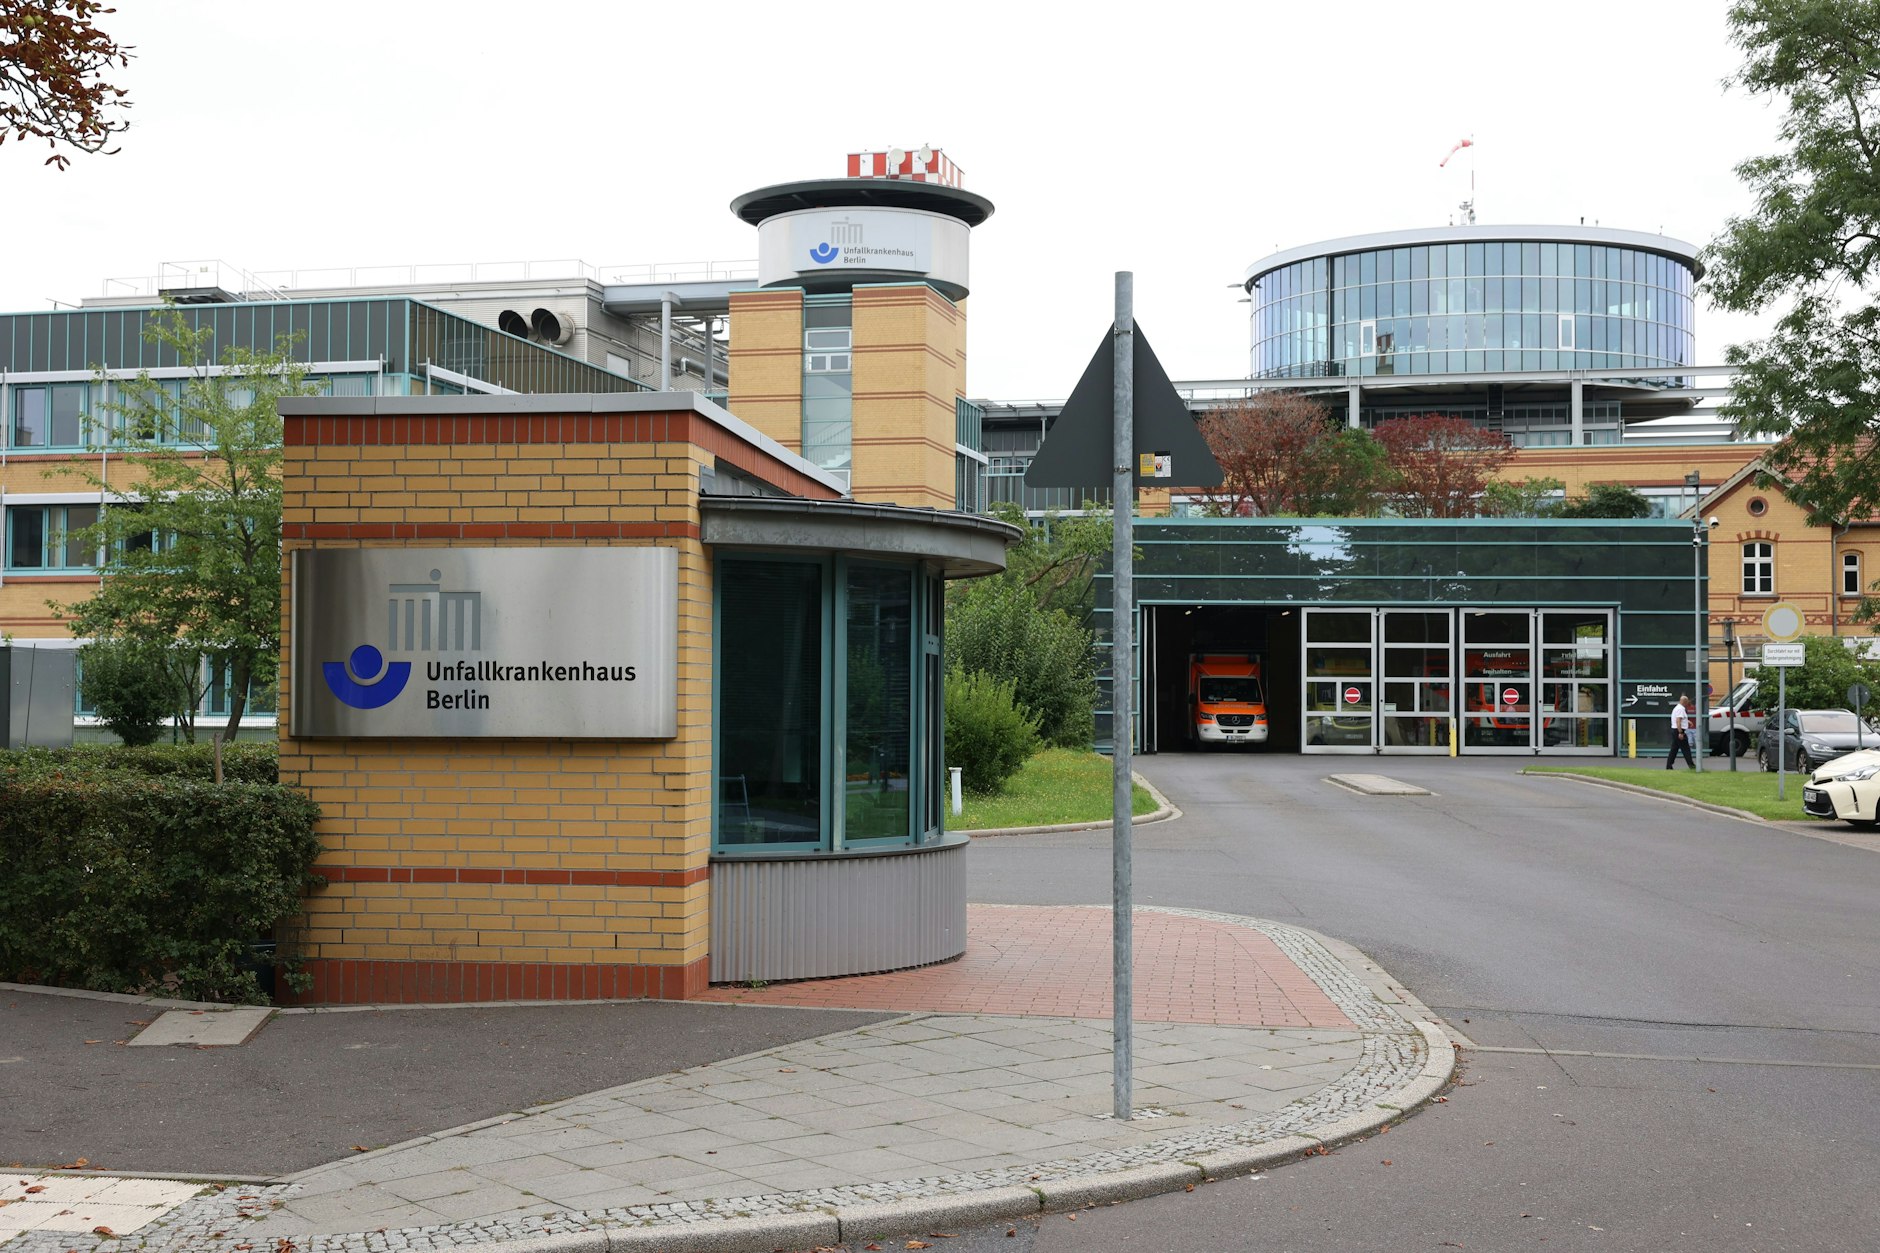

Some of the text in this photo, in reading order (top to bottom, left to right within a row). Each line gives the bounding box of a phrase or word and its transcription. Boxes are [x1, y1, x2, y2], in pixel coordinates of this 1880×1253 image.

[844, 247, 914, 256] Unfallkrankenhaus
[427, 660, 636, 682] Unfallkrankenhaus
[427, 689, 490, 710] Berlin
